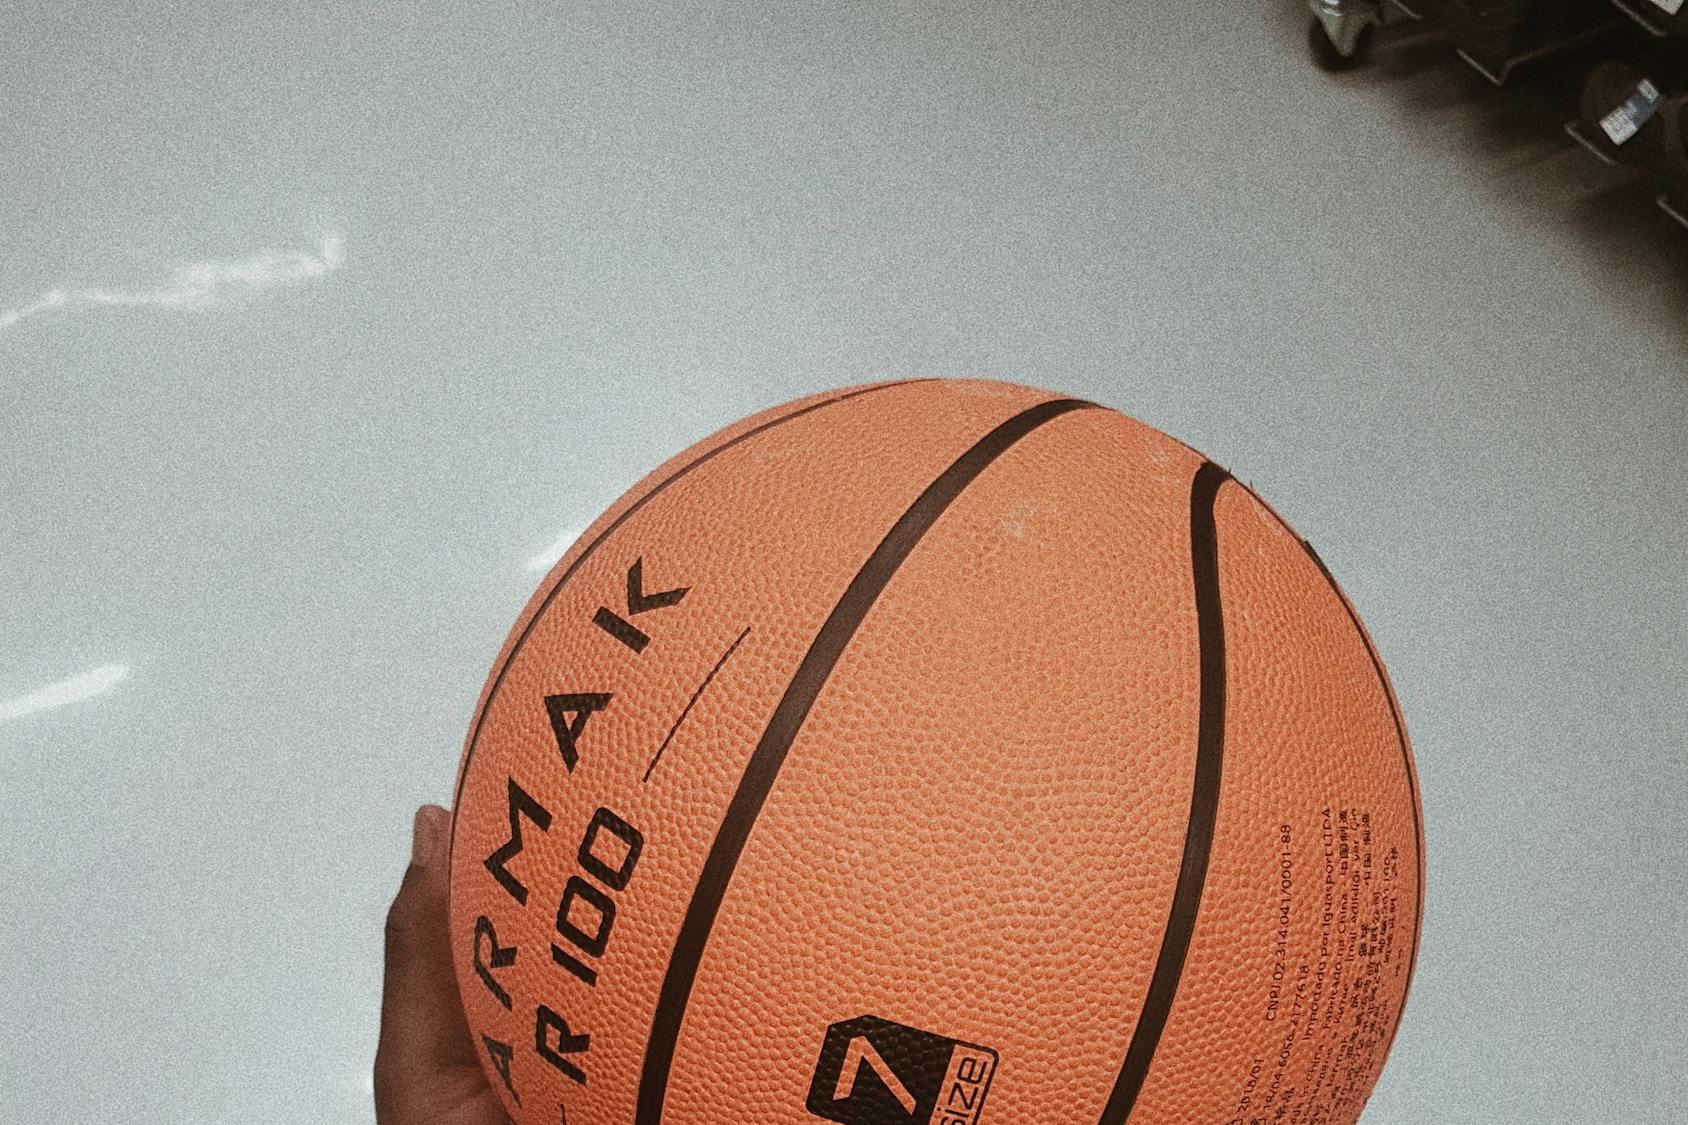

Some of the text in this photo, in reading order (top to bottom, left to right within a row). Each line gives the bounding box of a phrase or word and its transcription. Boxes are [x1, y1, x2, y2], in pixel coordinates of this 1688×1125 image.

[1322, 809, 1332, 847] LTDA
[535, 806, 645, 1085] R 100
[1266, 985, 1280, 1021] CNPJ
[832, 1034, 918, 1117] 7
